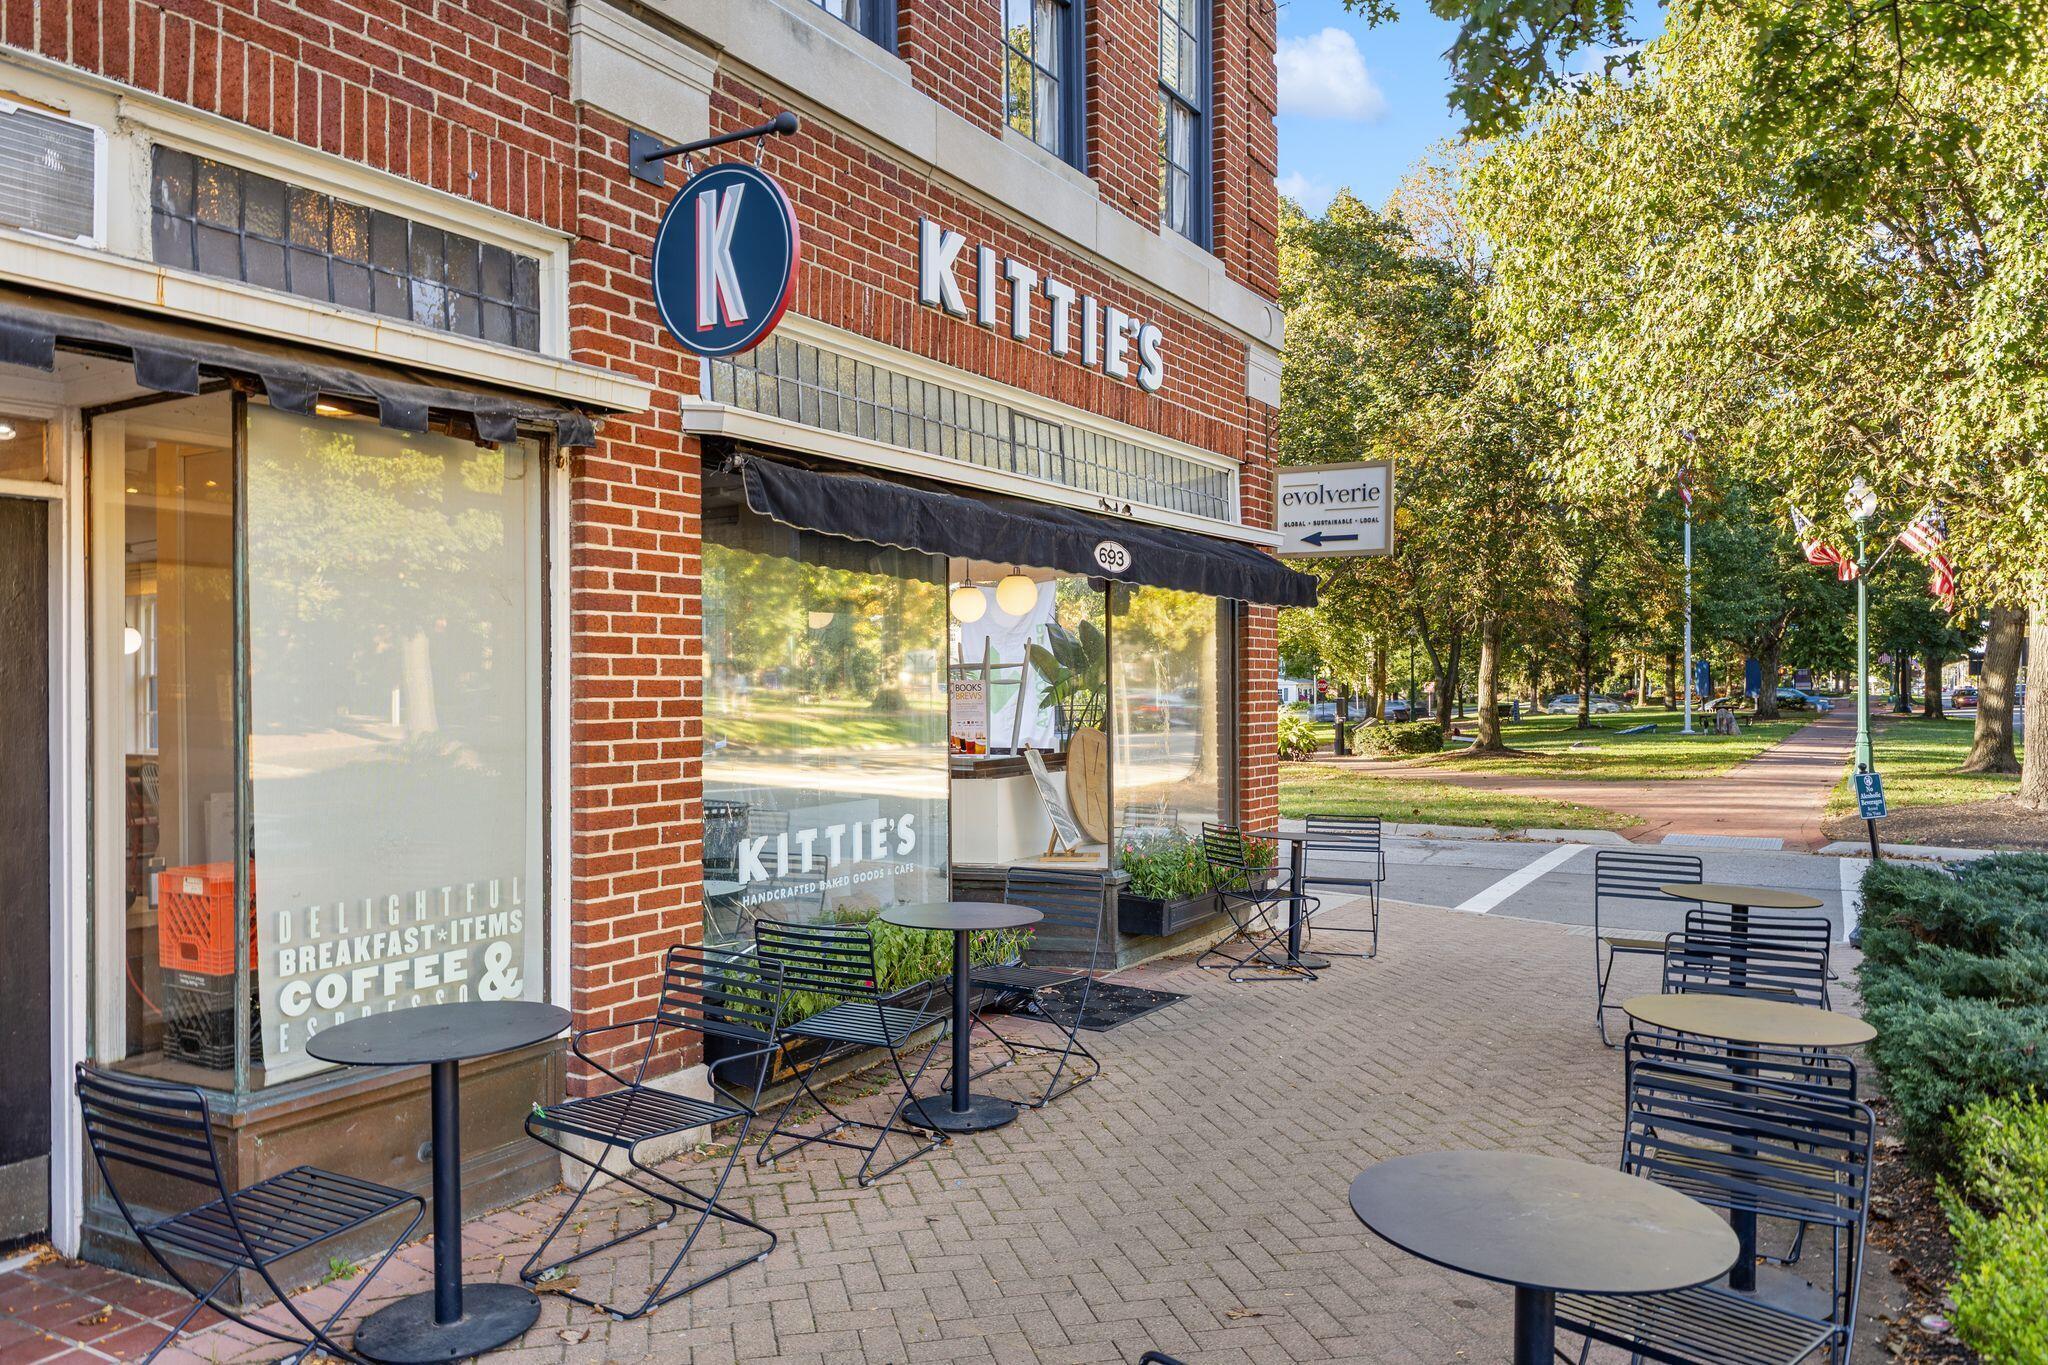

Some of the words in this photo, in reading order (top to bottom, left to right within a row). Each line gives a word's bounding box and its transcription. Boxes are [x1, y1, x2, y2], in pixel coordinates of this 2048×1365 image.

[696, 183, 748, 332] K
[919, 215, 1164, 393] KITTIE'S
[1282, 483, 1381, 507] evolverie
[1313, 518, 1353, 526] SUSTAINABLE
[1100, 547, 1124, 567] 693
[955, 683, 982, 692] BOOKS
[955, 692, 983, 700] BREWS
[738, 813, 916, 886] KITTIE'S
[742, 882, 816, 907] HANDCRAFTED
[819, 874, 850, 891] BAKED
[852, 868, 885, 884] GOODS
[894, 862, 914, 875] CAFE
[279, 877, 522, 945] DELIGHTFUL
[279, 948, 468, 1017] COFFEE
[478, 940, 523, 1001] &
